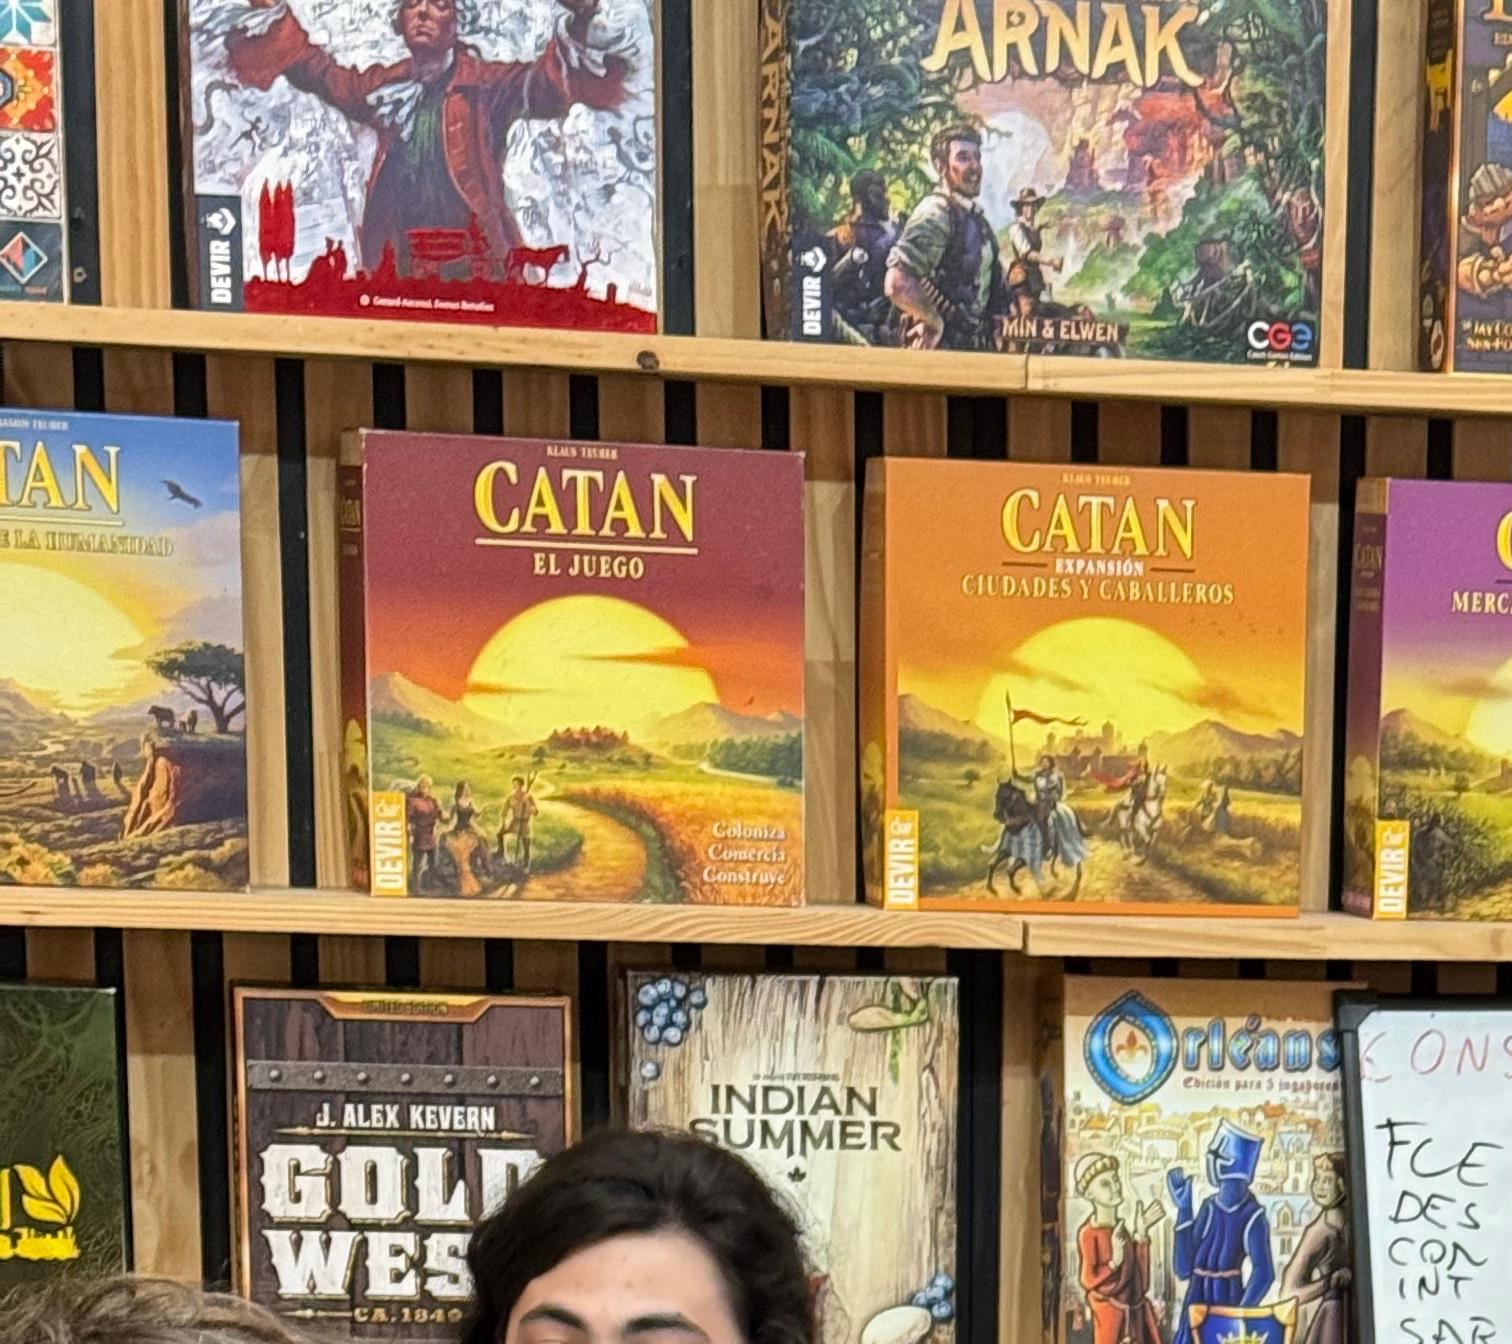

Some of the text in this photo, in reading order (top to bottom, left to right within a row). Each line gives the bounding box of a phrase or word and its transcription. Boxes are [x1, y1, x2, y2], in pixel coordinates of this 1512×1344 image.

[921, 0, 1203, 88] ARNAK
[212, 239, 231, 304] DEVIR
[803, 275, 822, 336] DEVIR
[1002, 317, 1119, 343] MIN & ELWEN
[1248, 322, 1313, 350] CGE
[475, 461, 698, 542] CATAN
[1002, 488, 1196, 561] CATAN
[534, 553, 645, 580] EL JUEGO
[1055, 558, 1144, 577] EXPANSIÓN
[962, 575, 1235, 605] CIUDADES Y CABALLEROS
[711, 821, 787, 842] Coloniza
[375, 819, 402, 891] DEVIR
[707, 843, 787, 864] Comercia
[888, 836, 916, 906] DEVIR
[702, 866, 787, 887] Construye
[1379, 849, 1405, 913] DEVIR
[1083, 989, 1342, 1105] Orléans
[709, 1083, 879, 1117] INDIAN
[316, 1103, 496, 1136] J. ALEX KEVERN
[689, 1118, 903, 1158] SUMMER
[1393, 1190, 1481, 1230] DES
[261, 1229, 473, 1300] WES
[1388, 1237, 1488, 1269] CON
[1398, 1276, 1473, 1301] INT
